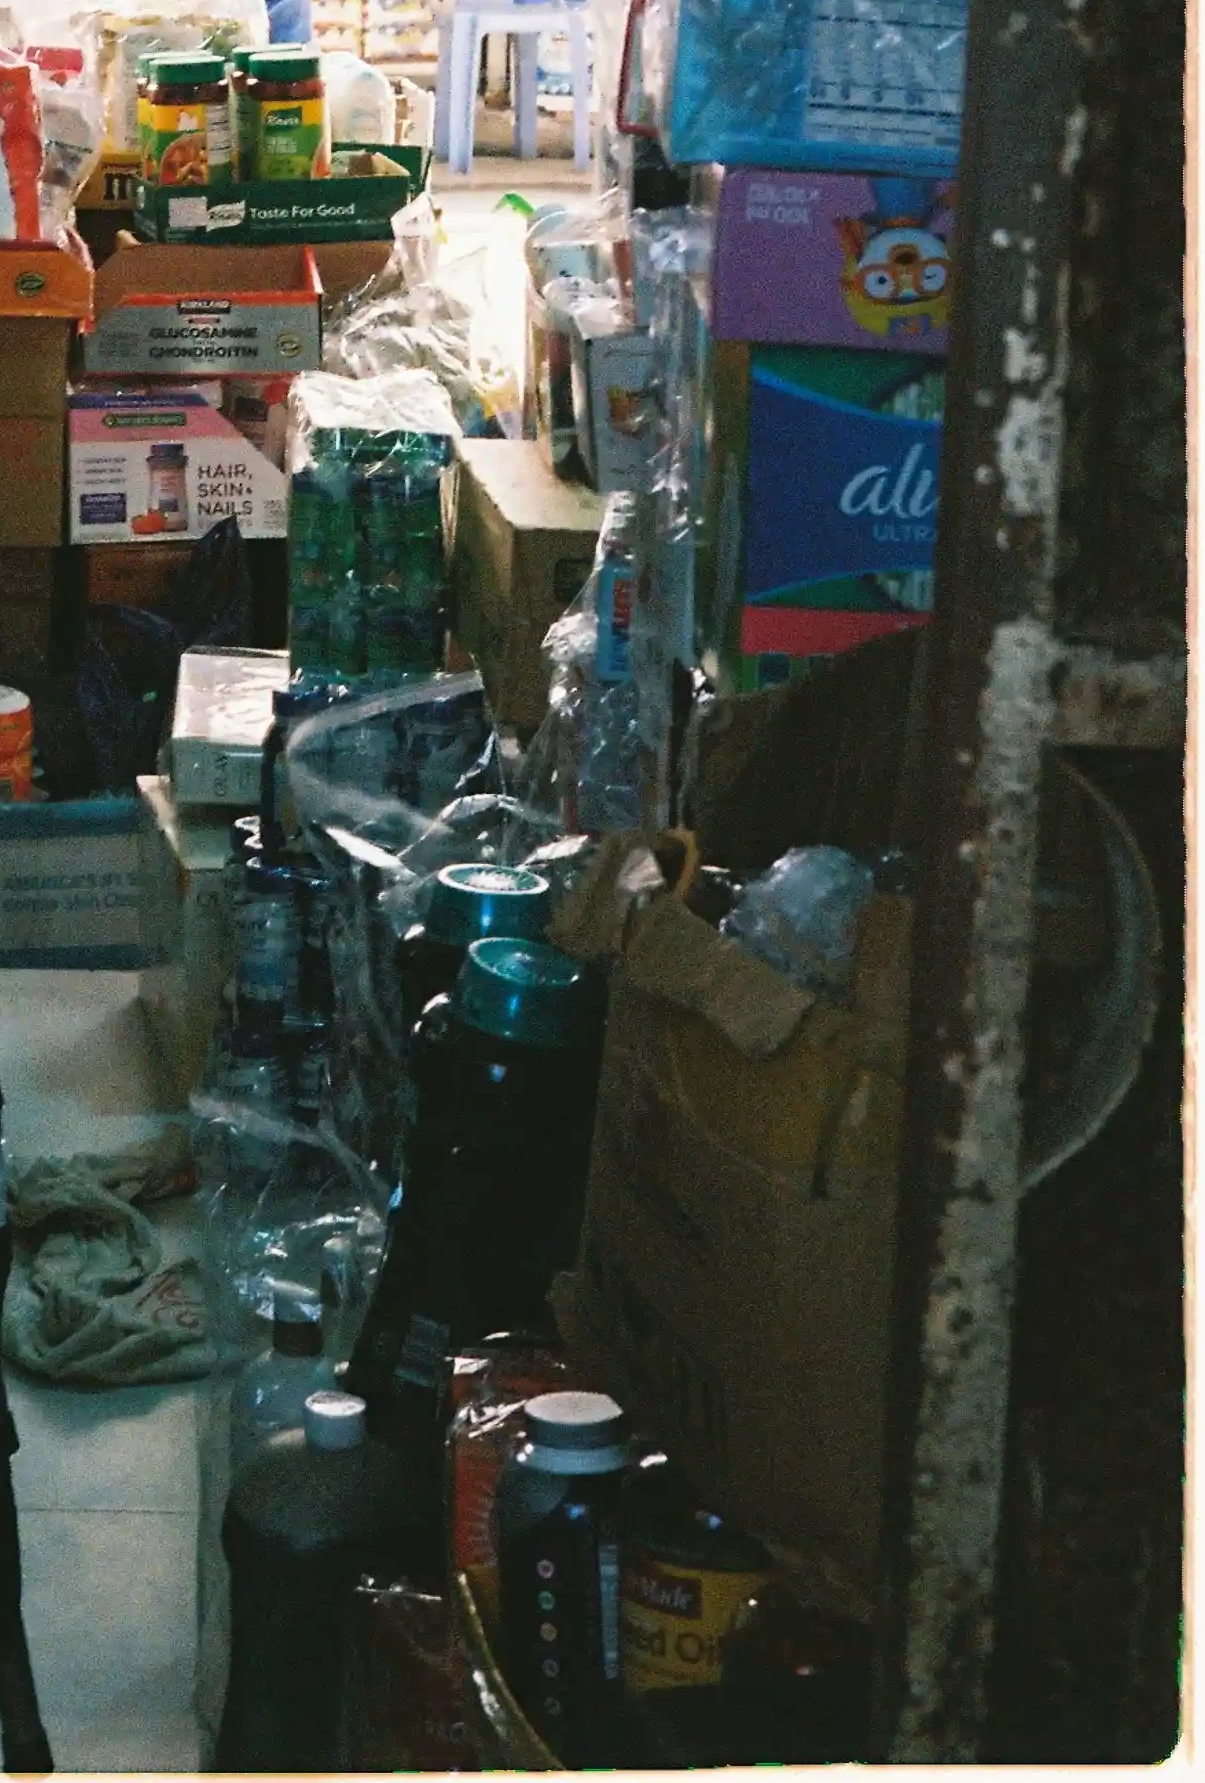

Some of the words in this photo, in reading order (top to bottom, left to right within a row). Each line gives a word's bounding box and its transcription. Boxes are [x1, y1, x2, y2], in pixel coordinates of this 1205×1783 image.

[250, 206, 289, 220] Taste
[291, 205, 315, 218] For
[317, 203, 356, 217] Good
[149, 326, 258, 340] GLUCOSAMINE
[149, 345, 259, 359] CHONDROITIN
[198, 463, 253, 480] HAIR,
[198, 501, 253, 516] NAILS
